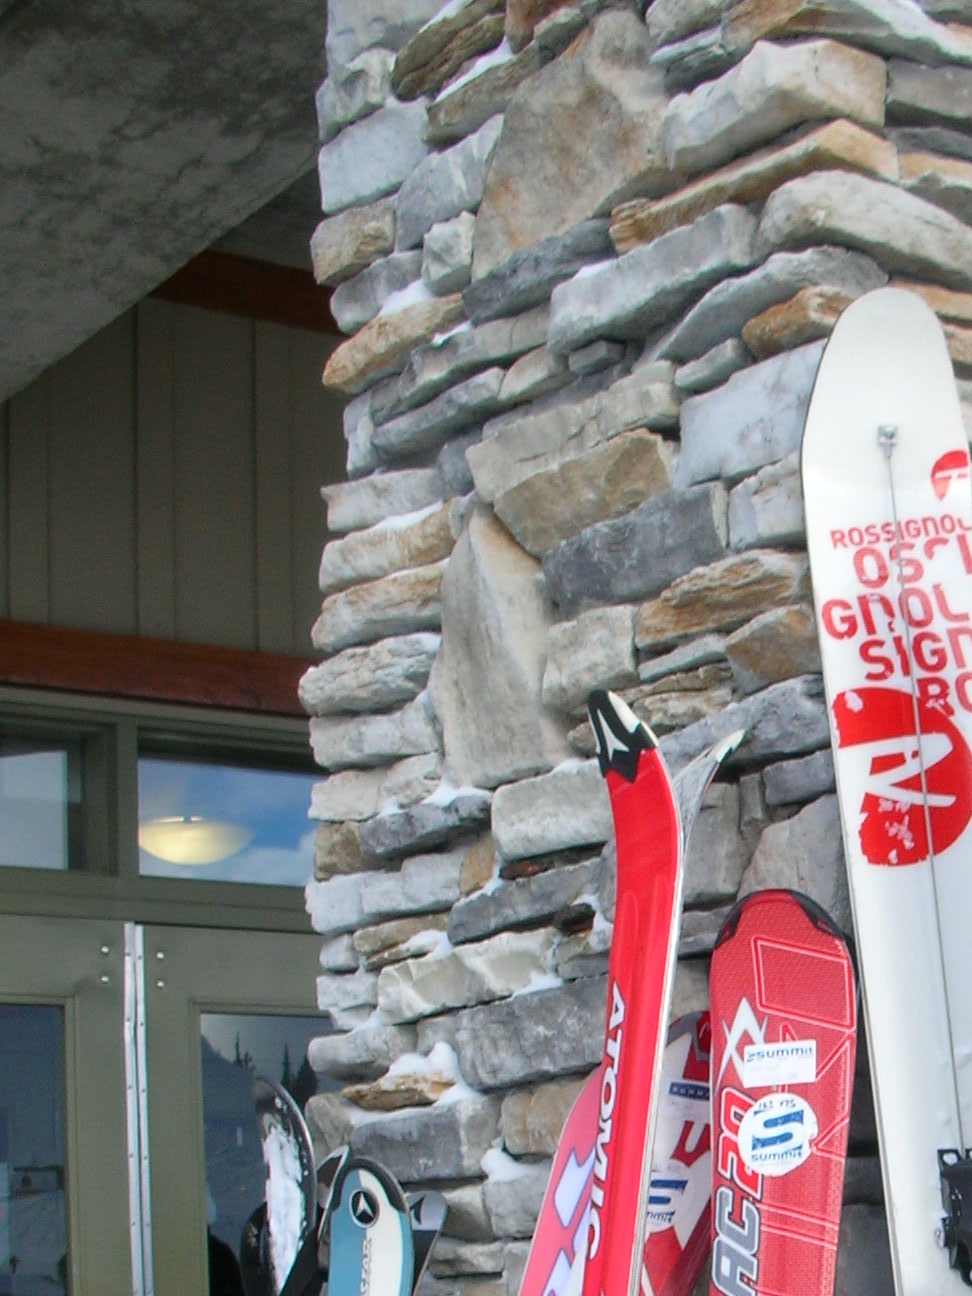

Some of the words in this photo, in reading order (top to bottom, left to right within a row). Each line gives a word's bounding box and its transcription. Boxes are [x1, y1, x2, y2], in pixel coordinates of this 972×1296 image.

[830, 514, 972, 550] ROSSIGNOL
[756, 1046, 814, 1059] summit
[586, 981, 625, 1260] ATOMIC
[751, 1150, 803, 1162] summit
